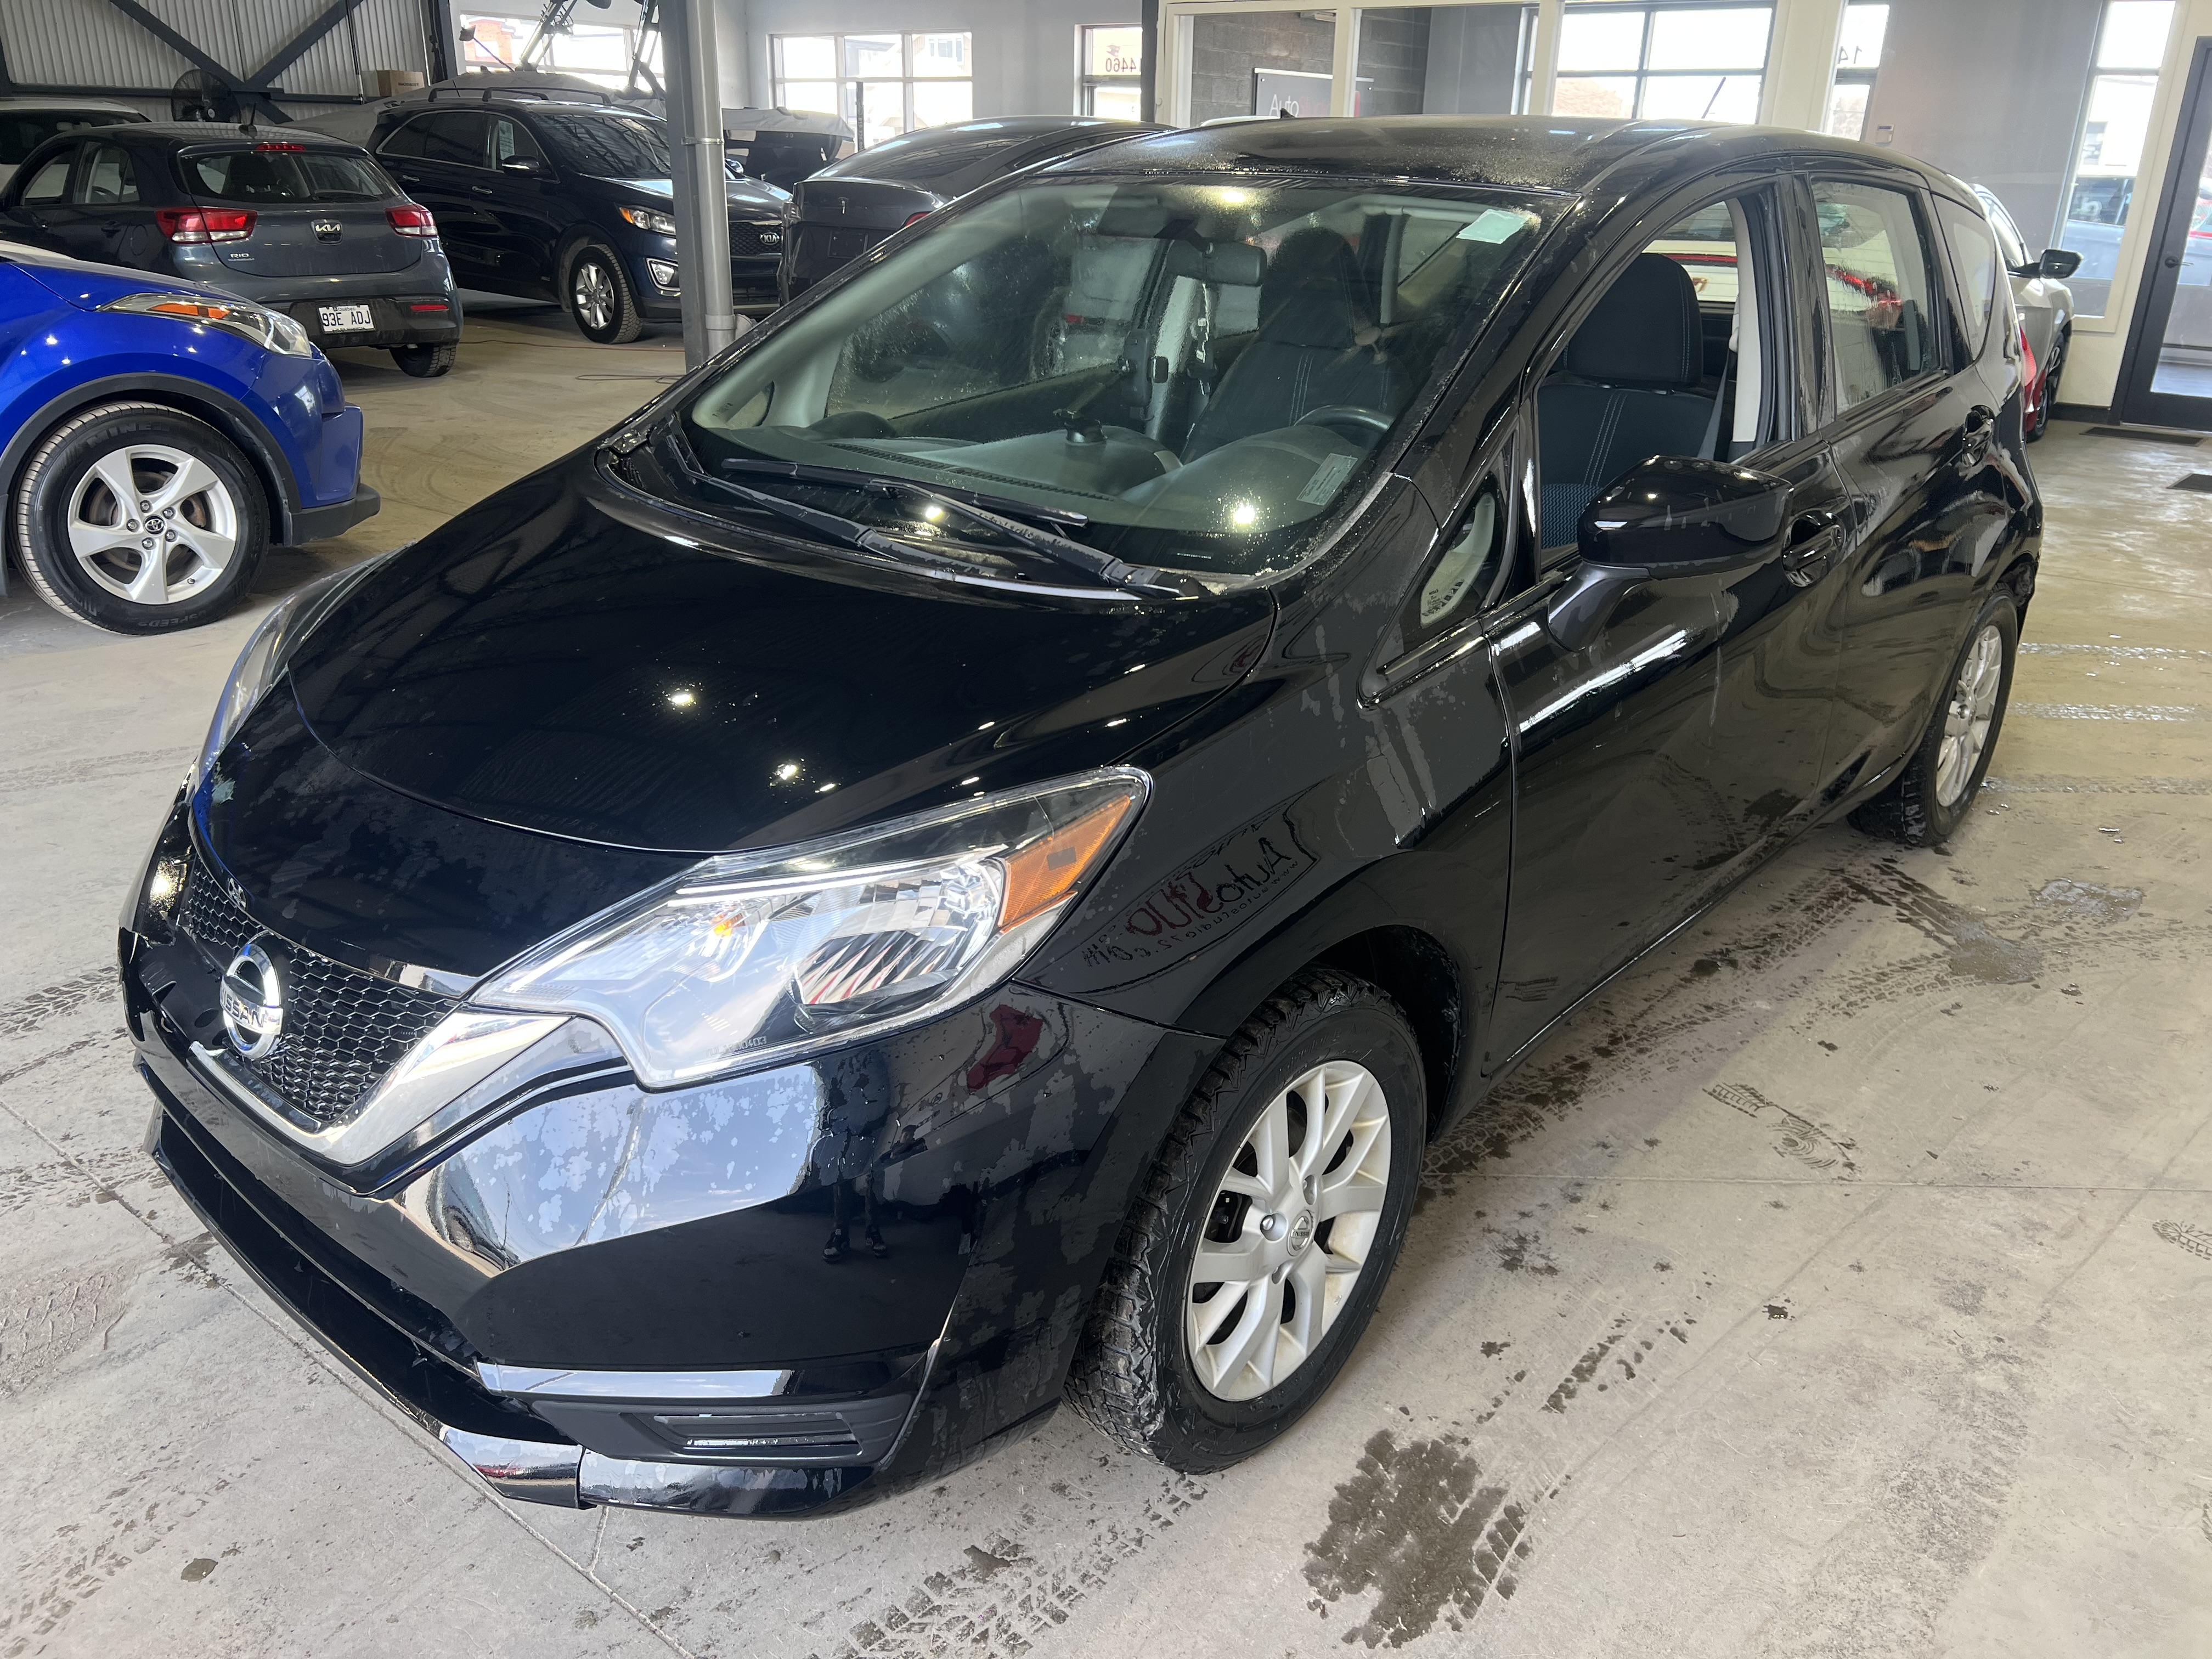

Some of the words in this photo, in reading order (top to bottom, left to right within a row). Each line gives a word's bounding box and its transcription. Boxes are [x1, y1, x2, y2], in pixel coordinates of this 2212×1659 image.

[315, 224, 340, 232] KIA
[322, 313, 343, 326] 93E
[351, 311, 371, 325] ADJ
[220, 986, 266, 1028] NISSAN
